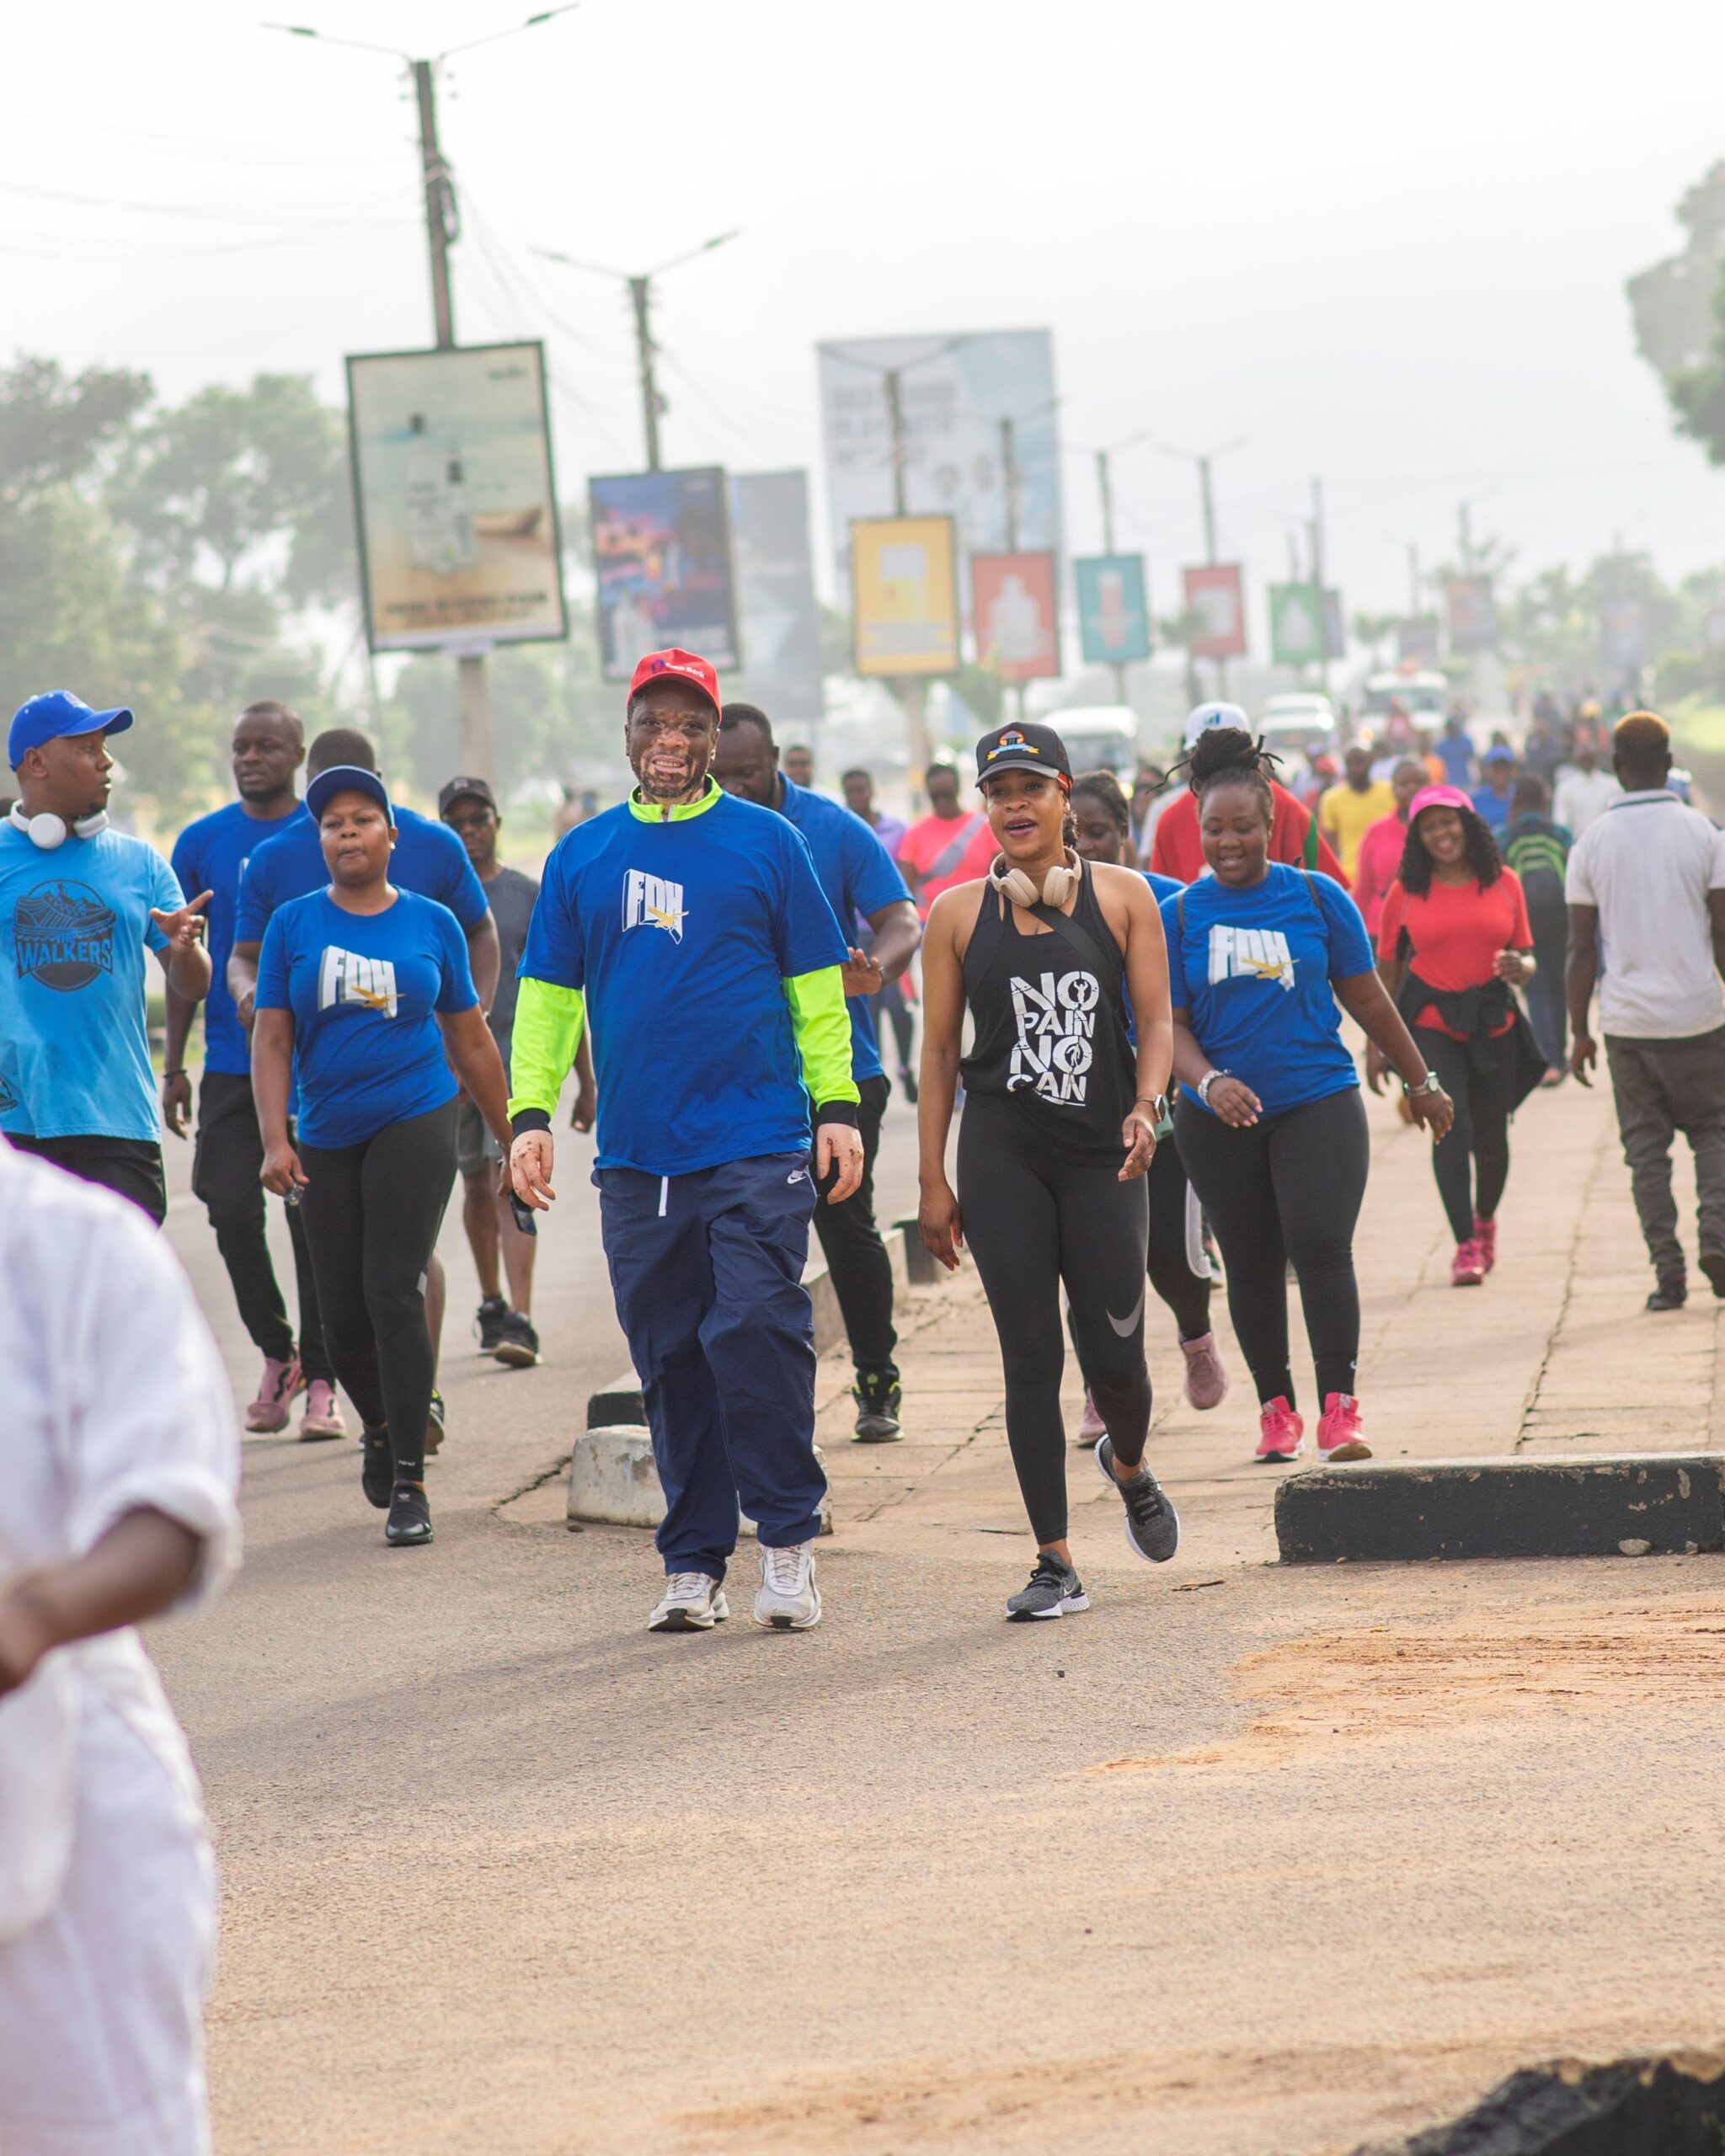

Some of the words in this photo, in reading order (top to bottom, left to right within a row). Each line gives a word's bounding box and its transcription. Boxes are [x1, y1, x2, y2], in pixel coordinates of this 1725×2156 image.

[622, 868, 684, 945] FDH
[16, 938, 112, 972] WALKERS
[1208, 924, 1295, 992] FDH
[318, 945, 398, 1019] FDH
[1009, 970, 1100, 1011] NO
[1015, 1010, 1096, 1038] PAIN
[1009, 1035, 1093, 1075] NO
